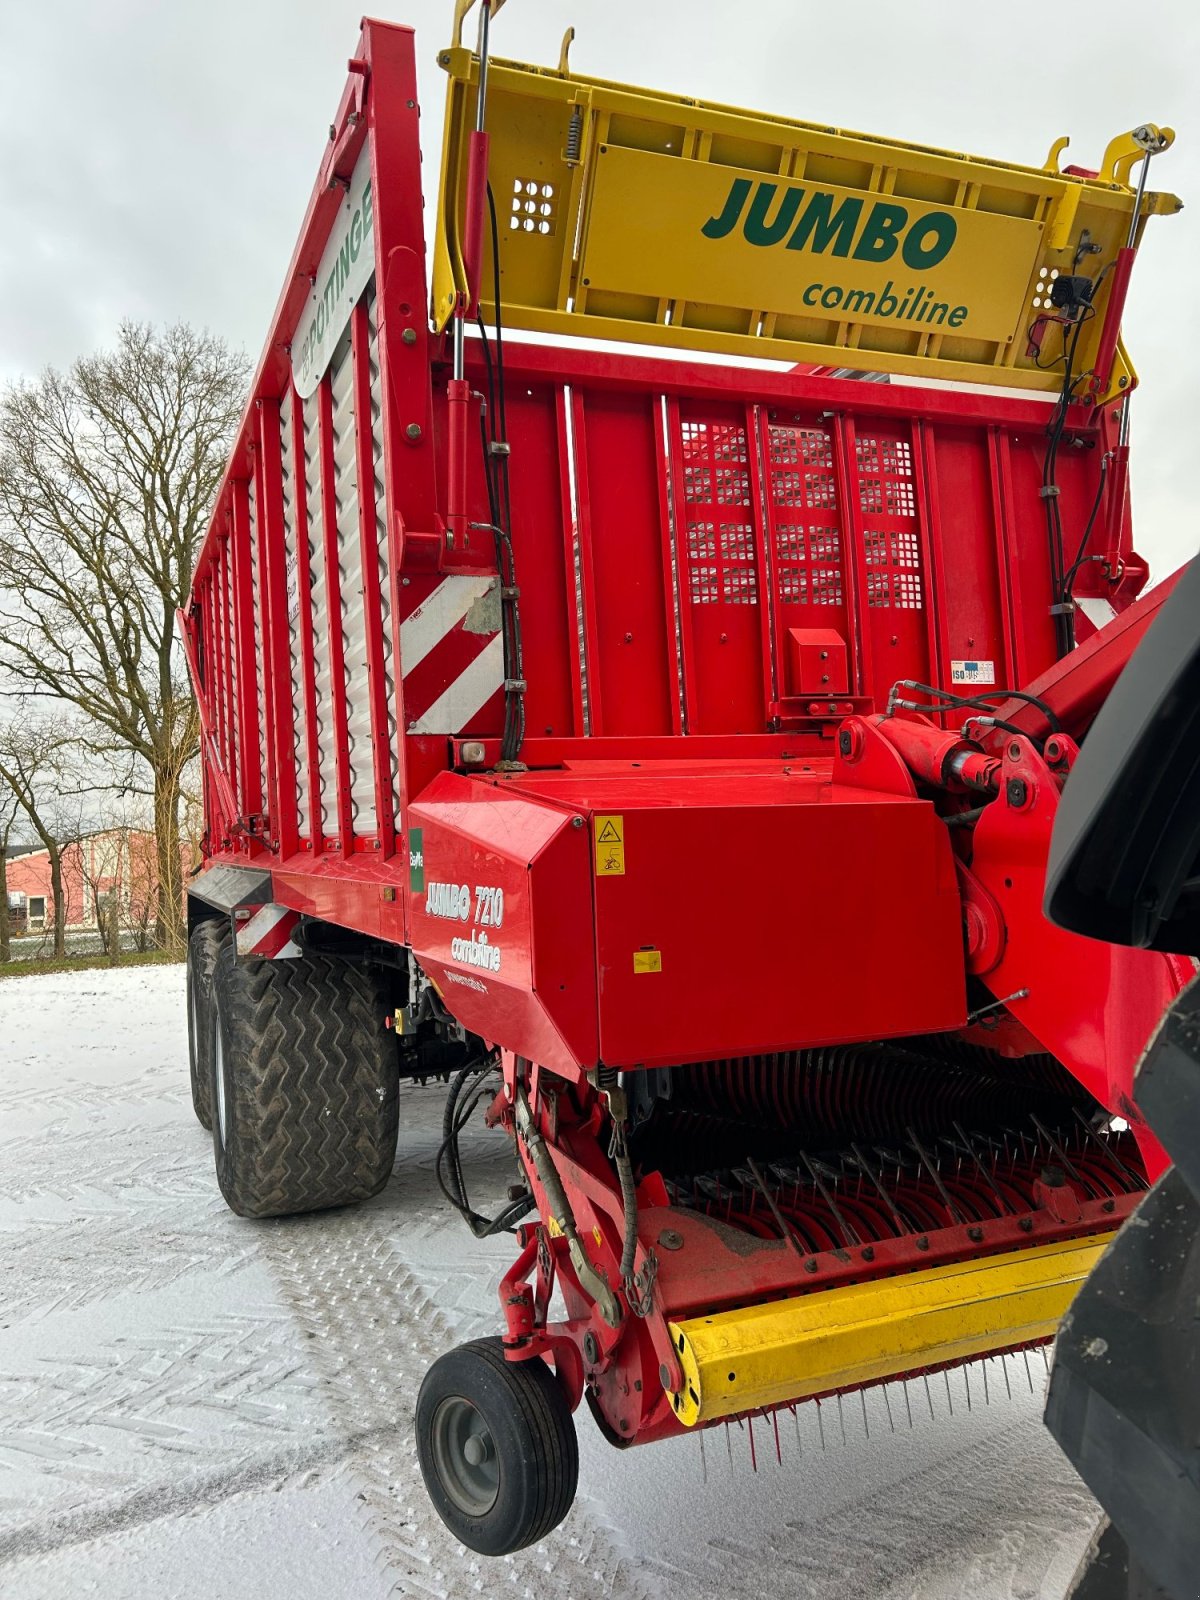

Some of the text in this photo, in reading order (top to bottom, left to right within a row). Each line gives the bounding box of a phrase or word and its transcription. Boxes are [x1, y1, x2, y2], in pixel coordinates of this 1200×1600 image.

[701, 178, 957, 270] JUMBO
[802, 281, 968, 328] combiline
[426, 882, 504, 928] JUMBO 7210
[451, 929, 501, 972] combiline
